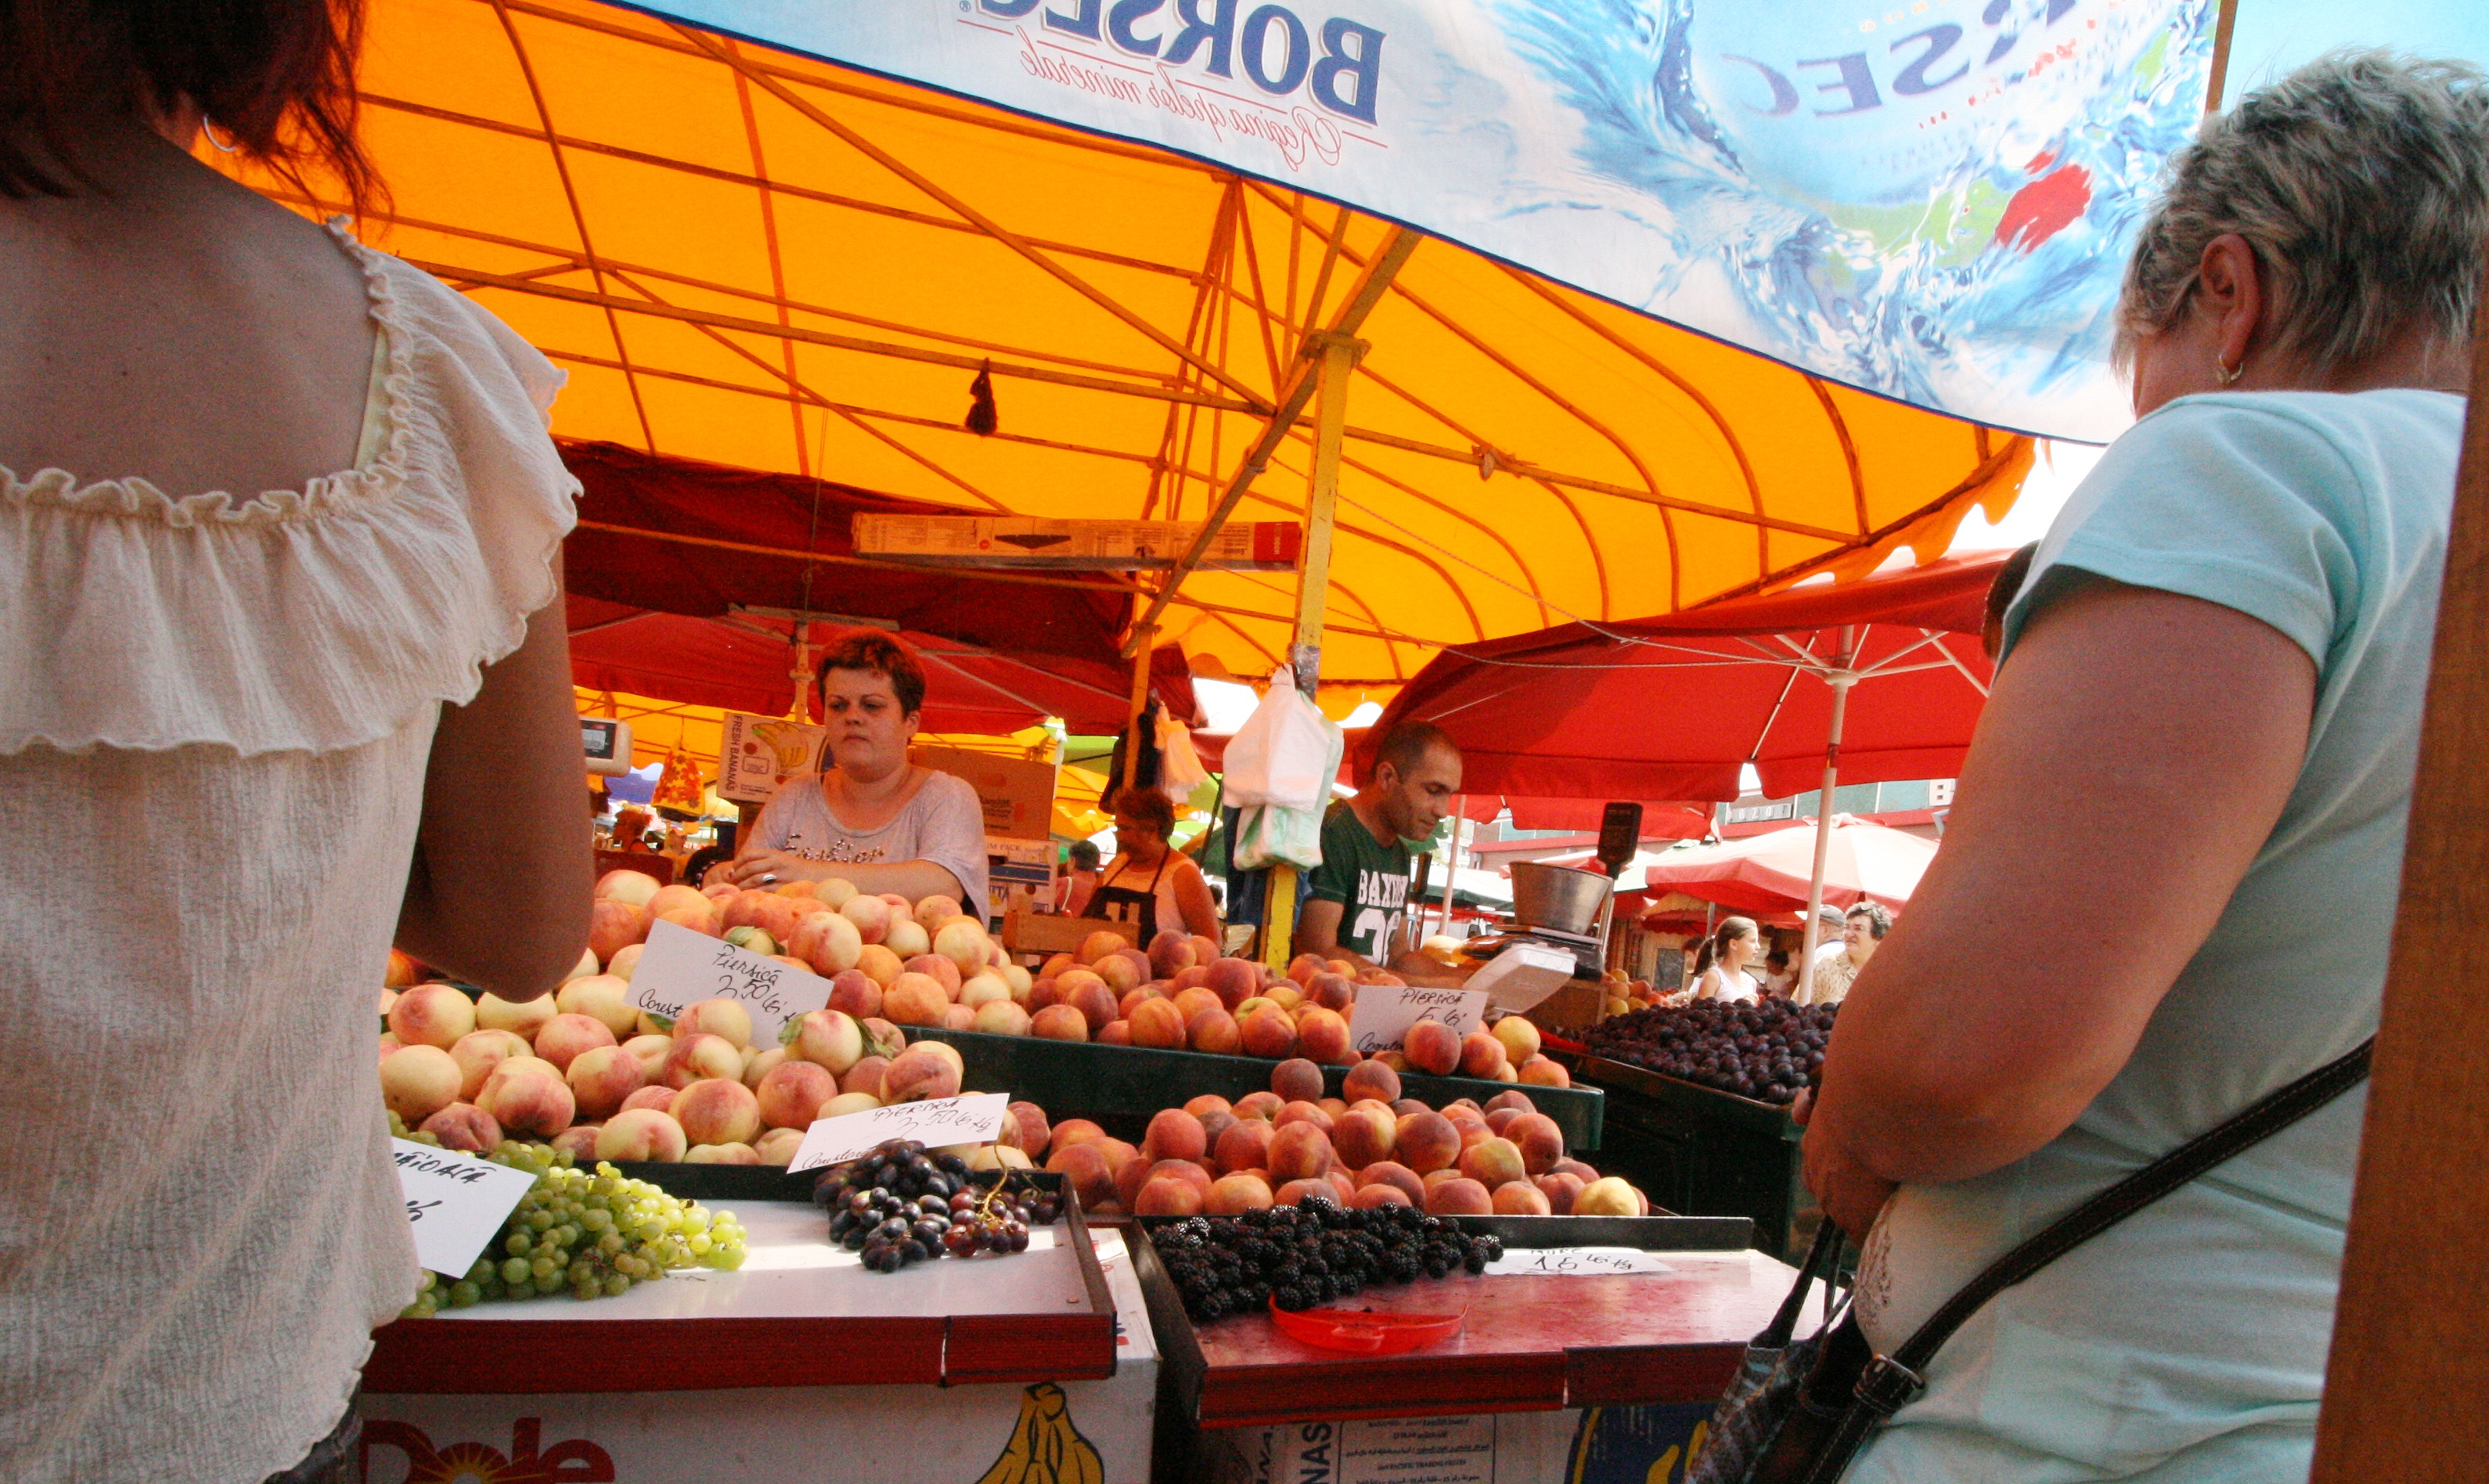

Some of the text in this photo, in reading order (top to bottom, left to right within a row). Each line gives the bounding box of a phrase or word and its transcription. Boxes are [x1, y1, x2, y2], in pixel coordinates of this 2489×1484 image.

[726, 715, 743, 791] FRESH BANANAS
[358, 1417, 616, 1484] Dole
